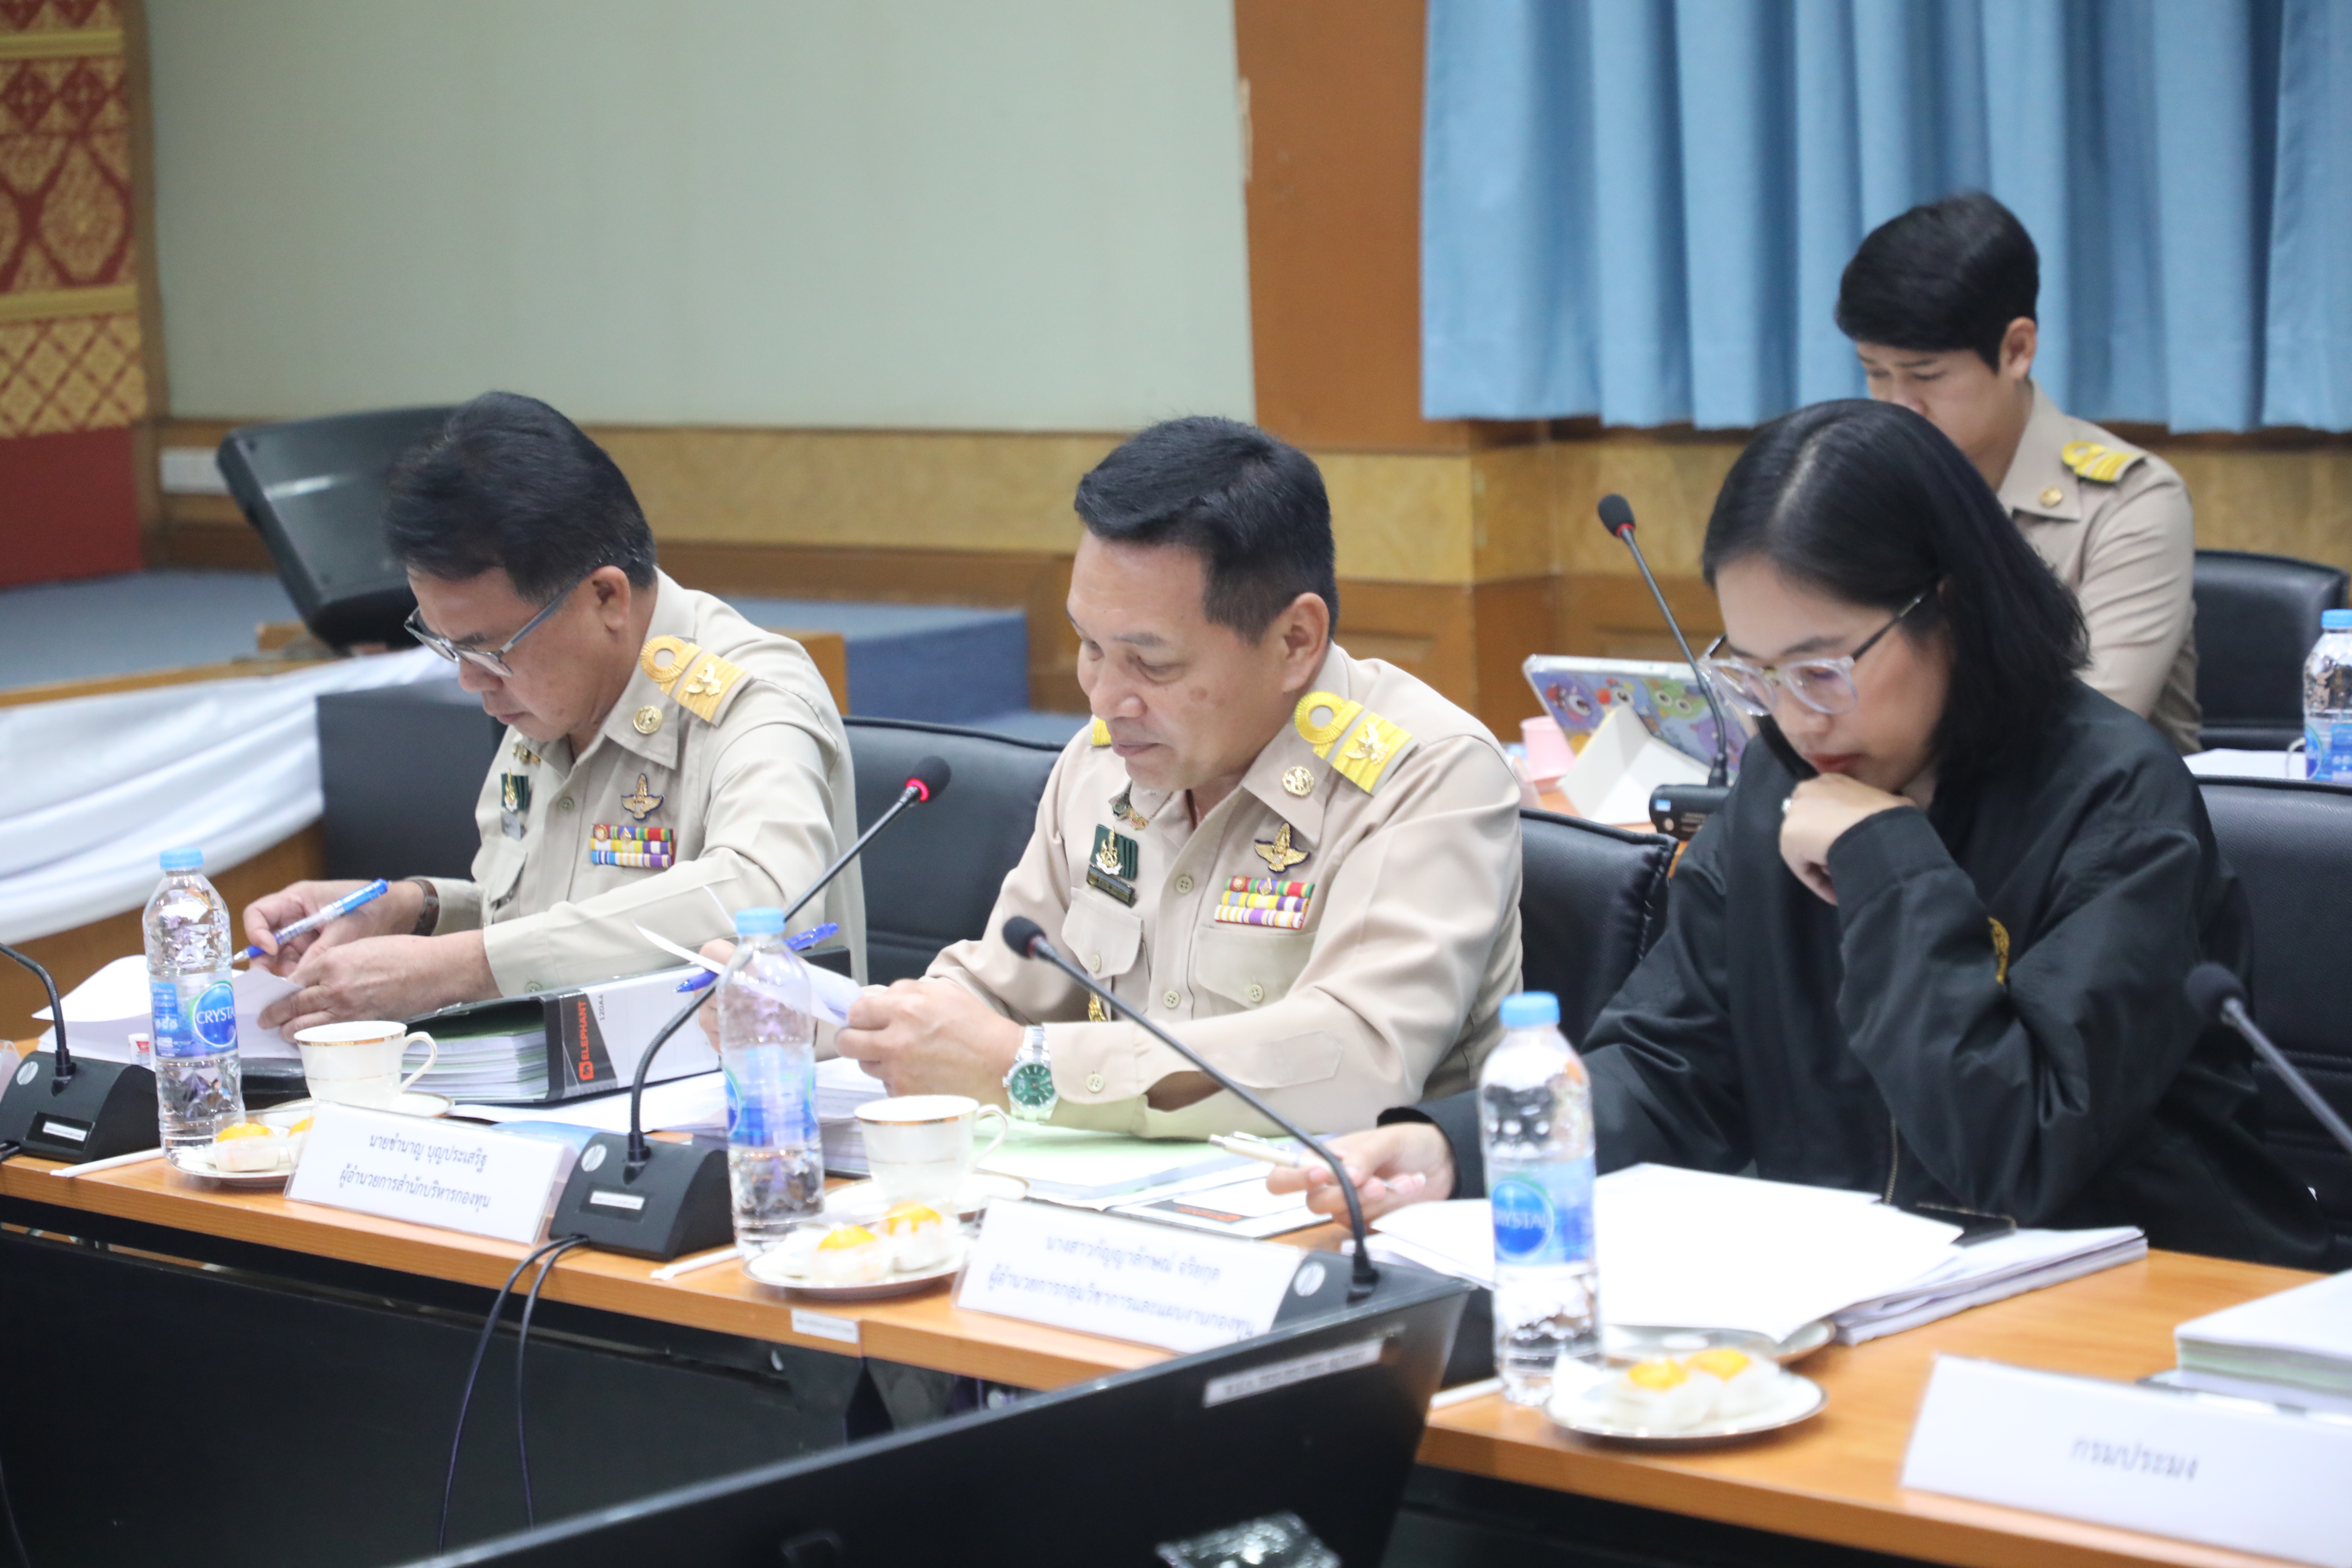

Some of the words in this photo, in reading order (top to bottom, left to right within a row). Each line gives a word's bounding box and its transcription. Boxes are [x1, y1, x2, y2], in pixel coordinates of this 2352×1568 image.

[196, 1005, 235, 1024] CRYSTA
[577, 1001, 590, 1061] ELEPHANT
[369, 1133, 424, 1161] นายชำนาญ
[427, 1145, 488, 1173] บุญประเสริฐ
[339, 1163, 491, 1213] ผู้อำนวยการสำนักบริหารกองทุน
[2070, 1437, 2200, 1481] กรมประมง
